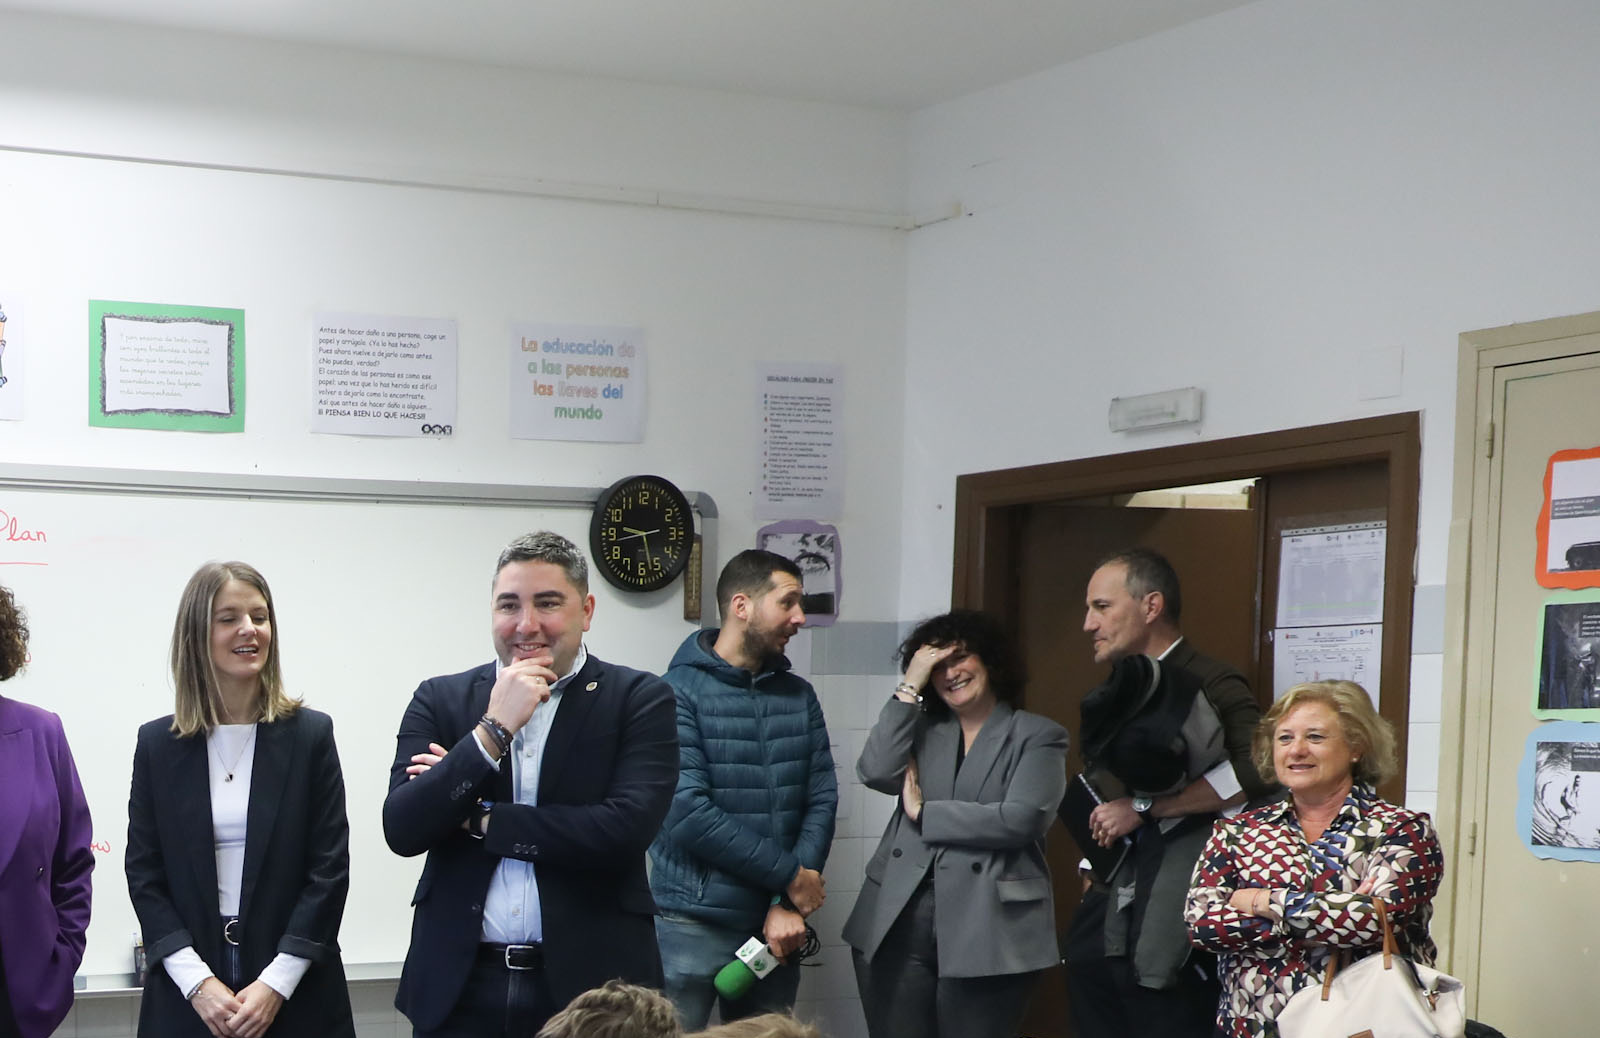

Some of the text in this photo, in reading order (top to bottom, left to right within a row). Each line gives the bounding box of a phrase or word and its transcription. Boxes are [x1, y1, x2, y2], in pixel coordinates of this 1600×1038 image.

[521, 337, 538, 352] La
[542, 338, 614, 356] educación
[528, 359, 630, 380] a las personas
[533, 380, 623, 399] las llaves del
[554, 403, 603, 419] mundo
[623, 496, 632, 510] 11
[639, 491, 649, 505] 12
[611, 508, 622, 522] 10
[665, 508, 673, 522] 2
[608, 527, 616, 541] 9
[669, 527, 677, 540] 3
[612, 546, 620, 559] 8
[664, 545, 672, 558] 4
[622, 557, 631, 571] 7
[638, 562, 646, 576] 6
[653, 557, 661, 571] 5
